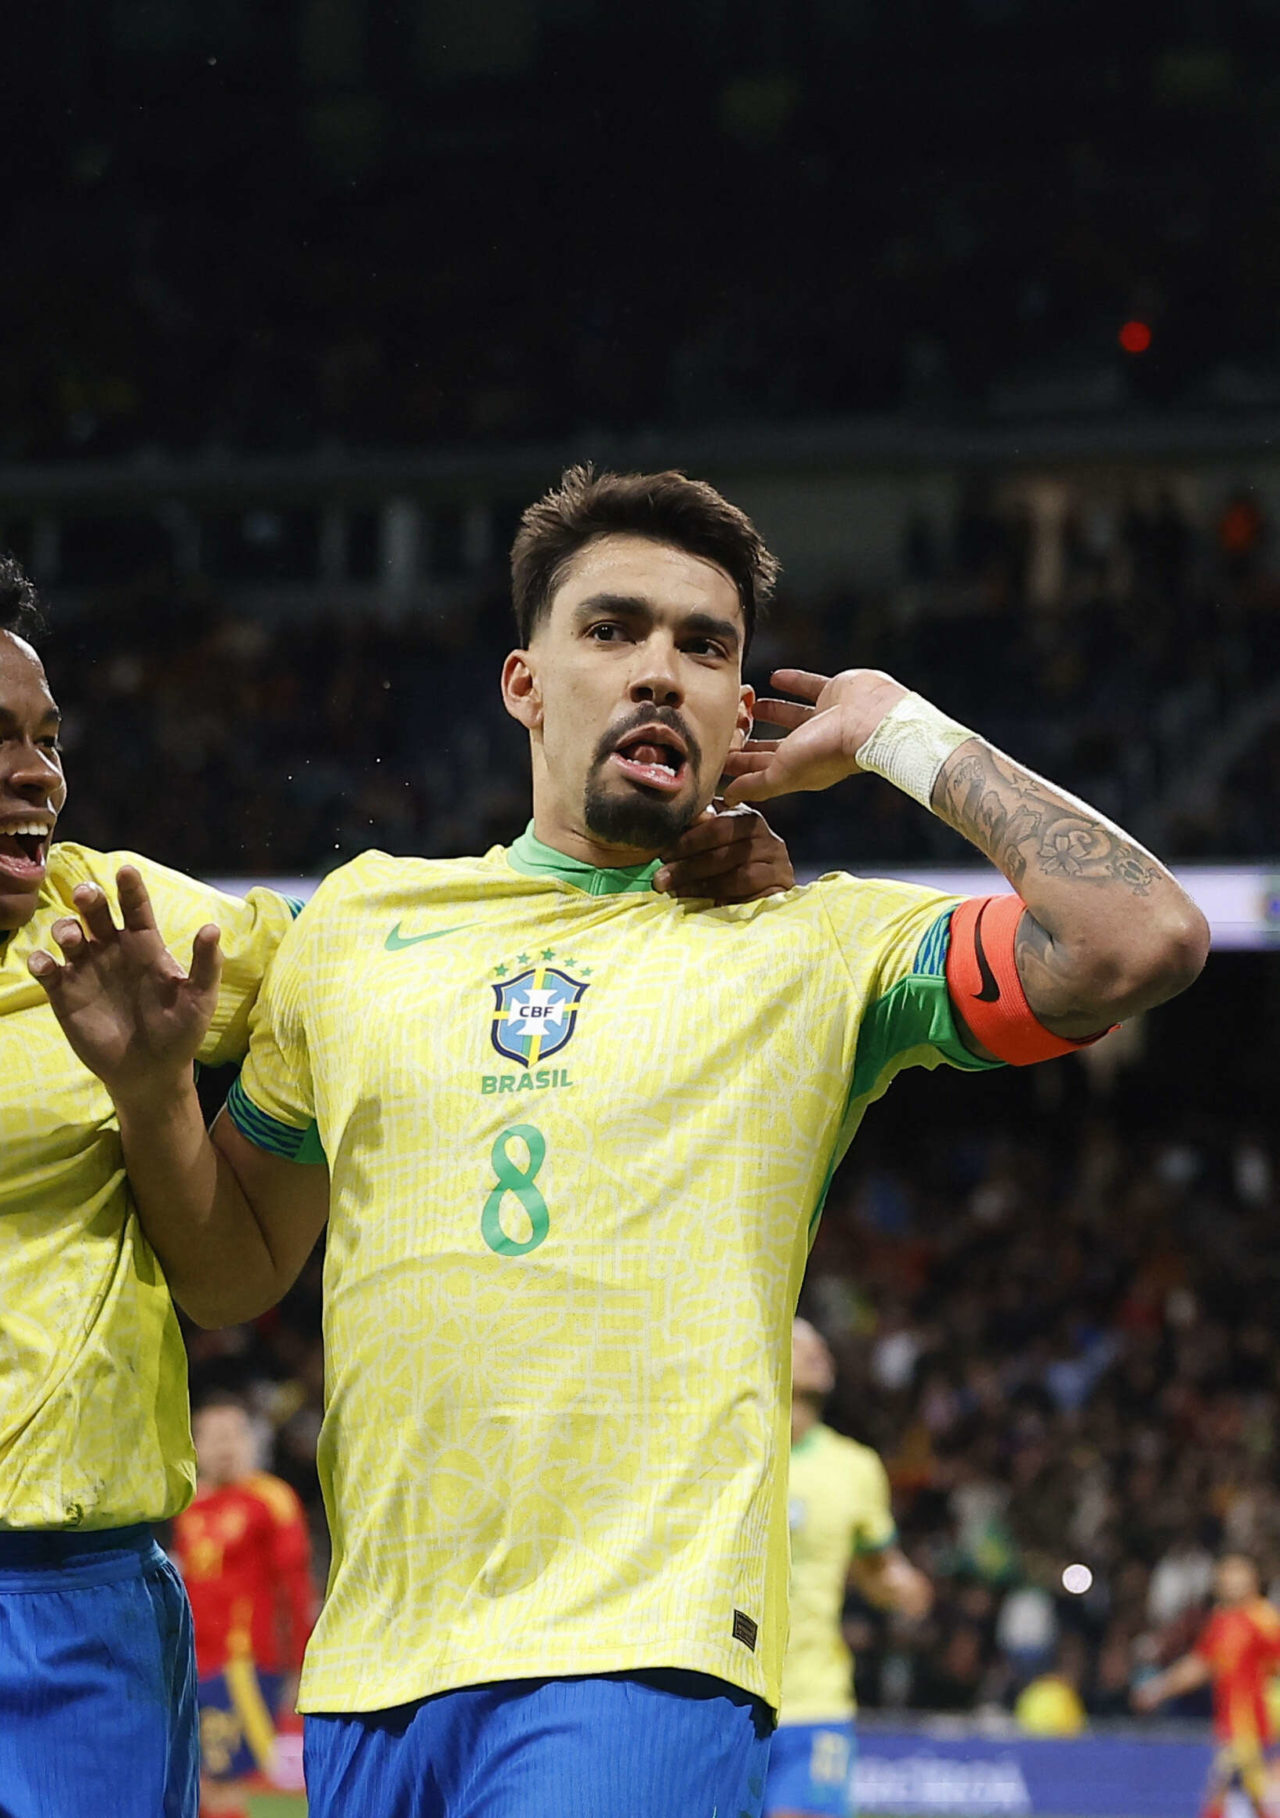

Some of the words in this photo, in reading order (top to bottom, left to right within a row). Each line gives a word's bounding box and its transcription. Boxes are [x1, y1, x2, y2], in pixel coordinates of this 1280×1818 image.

[519, 1005, 555, 1018] CBF
[481, 1069, 574, 1095] BRASIL
[481, 1124, 550, 1257] 8
